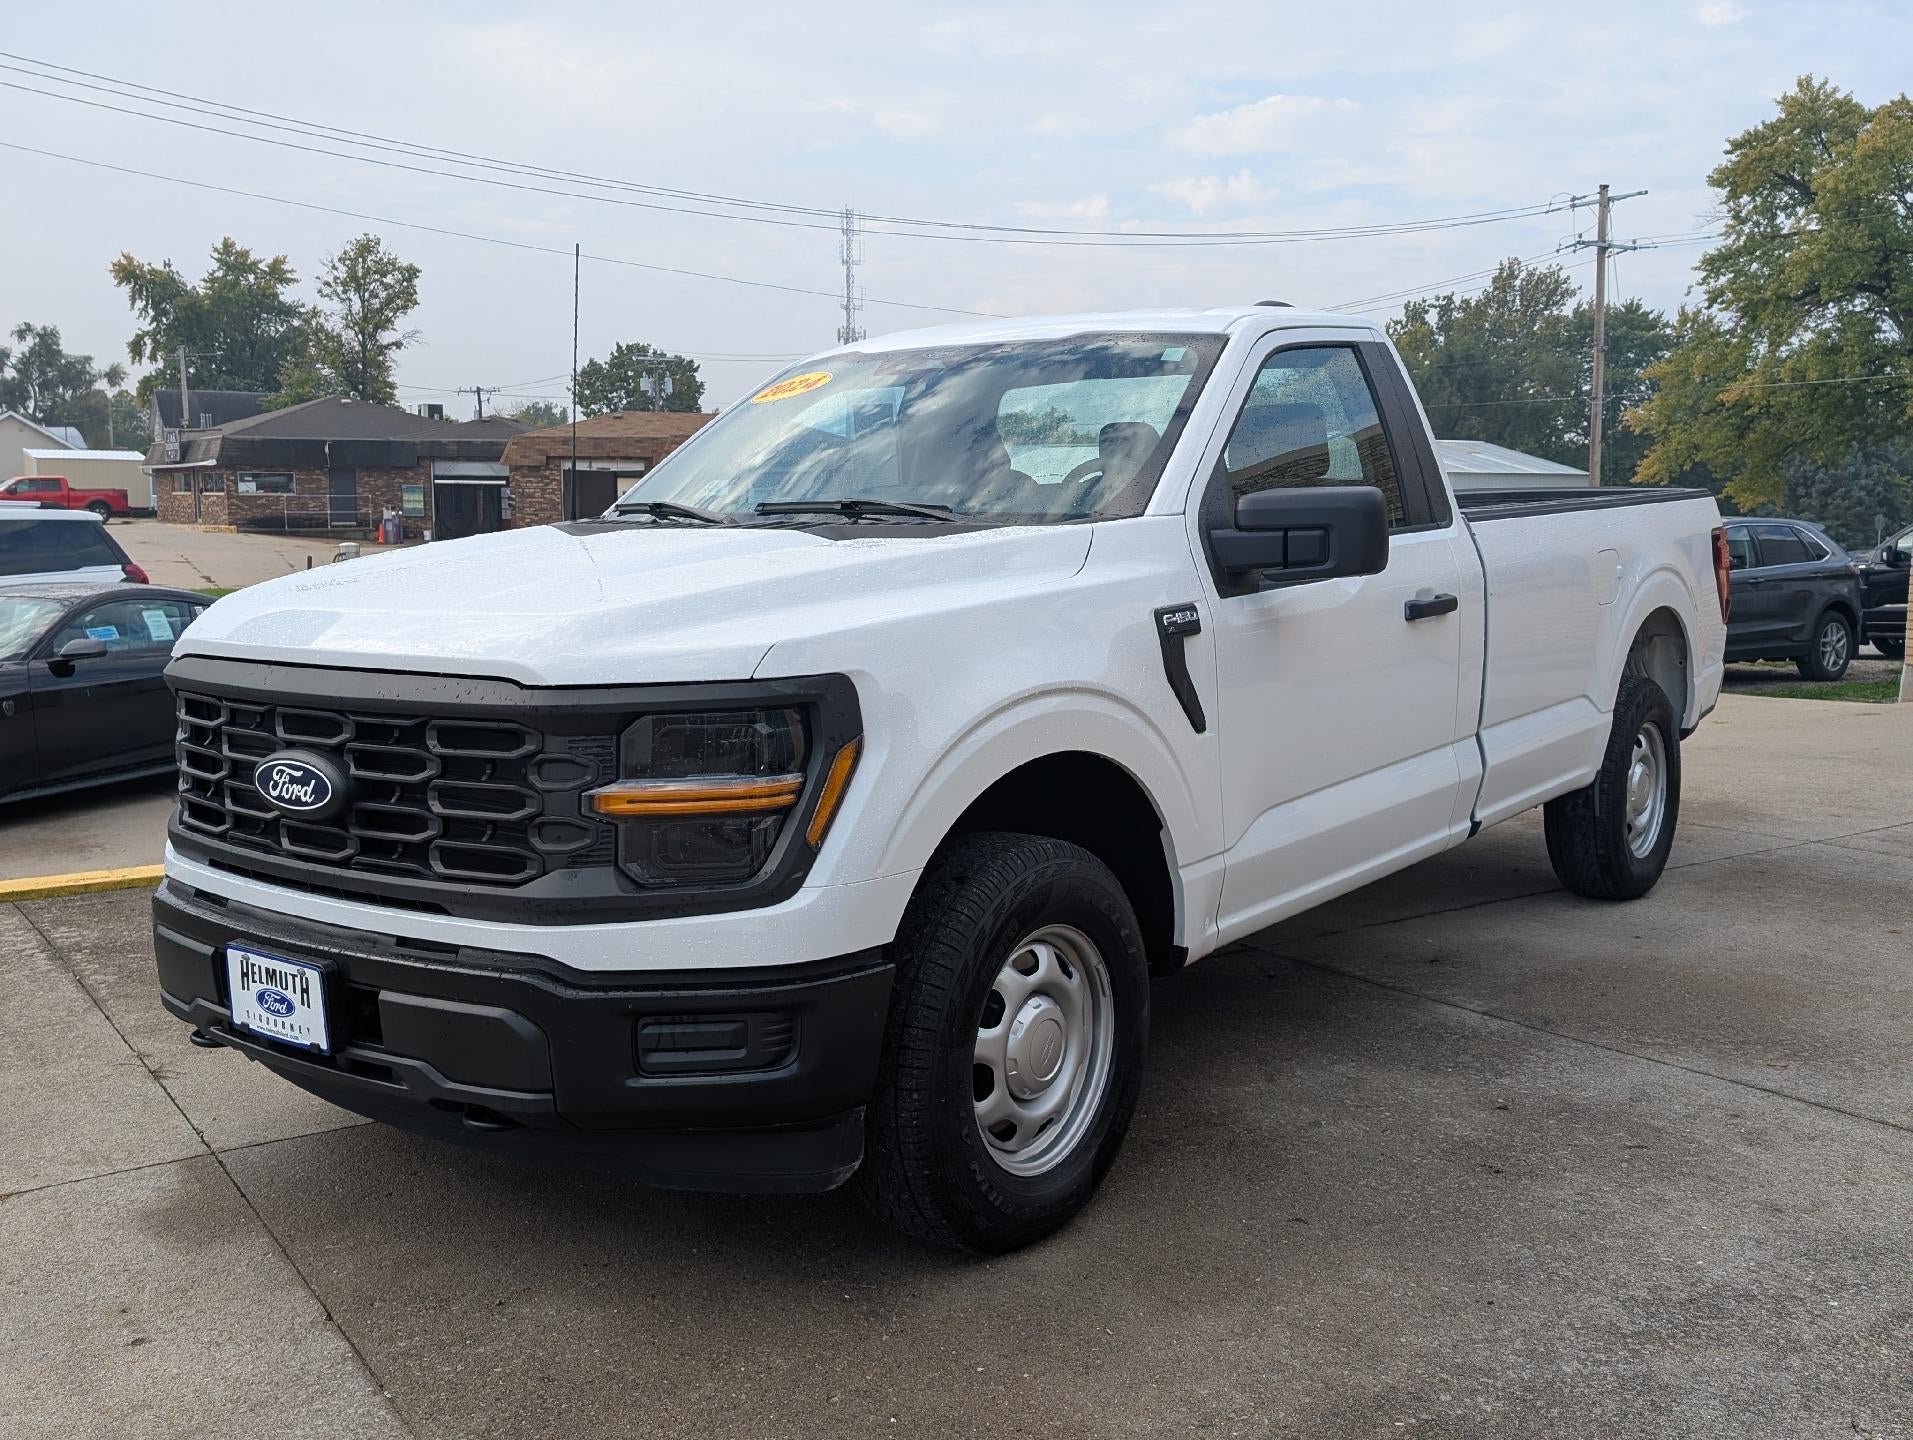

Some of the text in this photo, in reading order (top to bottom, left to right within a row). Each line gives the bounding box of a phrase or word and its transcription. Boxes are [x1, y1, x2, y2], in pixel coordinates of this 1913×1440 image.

[269, 765, 316, 803] Ford
[240, 959, 311, 1009] HELMUTH
[262, 991, 289, 1014] Ford
